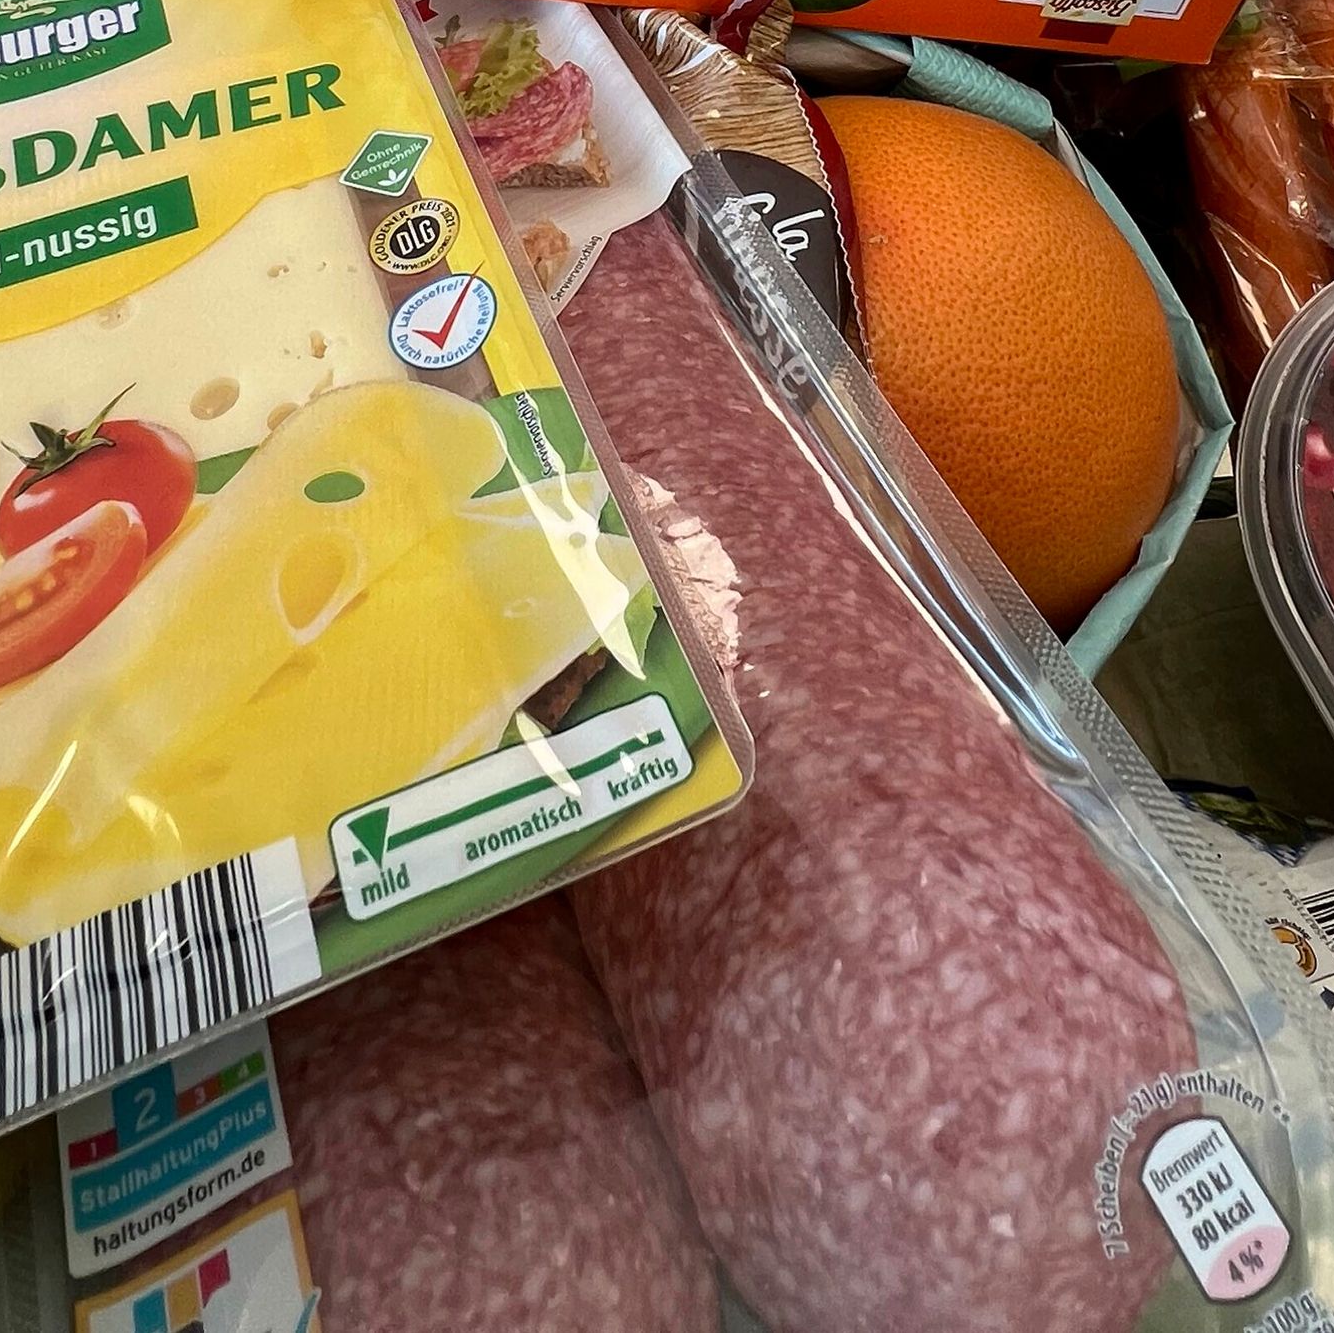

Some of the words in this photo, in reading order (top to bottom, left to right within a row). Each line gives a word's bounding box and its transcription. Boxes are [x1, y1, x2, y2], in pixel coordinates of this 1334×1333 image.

[350, 141, 423, 182] Gentechnik
[366, 142, 401, 164] Ohne
[374, 209, 409, 262] GOLDENER
[411, 199, 442, 215] PREIS
[395, 215, 437, 257] DLG
[550, 234, 604, 304] Serviervorschlag
[396, 332, 422, 361] Durch
[423, 327, 486, 366] natürliche
[472, 282, 490, 328] Reifung
[360, 862, 412, 907] mild
[464, 796, 583, 863] aromatisch
[607, 754, 680, 803] kräftig
[132, 1086, 162, 1133] 2
[193, 1087, 208, 1106] 3
[78, 1097, 270, 1214] StallhaltungPlus
[1095, 1135, 1128, 1243] Scheiben
[1176, 1070, 1267, 1115] enthalten
[1149, 1128, 1225, 1194] Brennwert
[92, 1145, 267, 1258] haltungsform.de
[1176, 1179, 1214, 1220] 330
[1209, 1162, 1234, 1196] kJ
[1191, 1219, 1219, 1252] 80
[1217, 1189, 1257, 1235] kcal
[1227, 1259, 1245, 1284] 4
